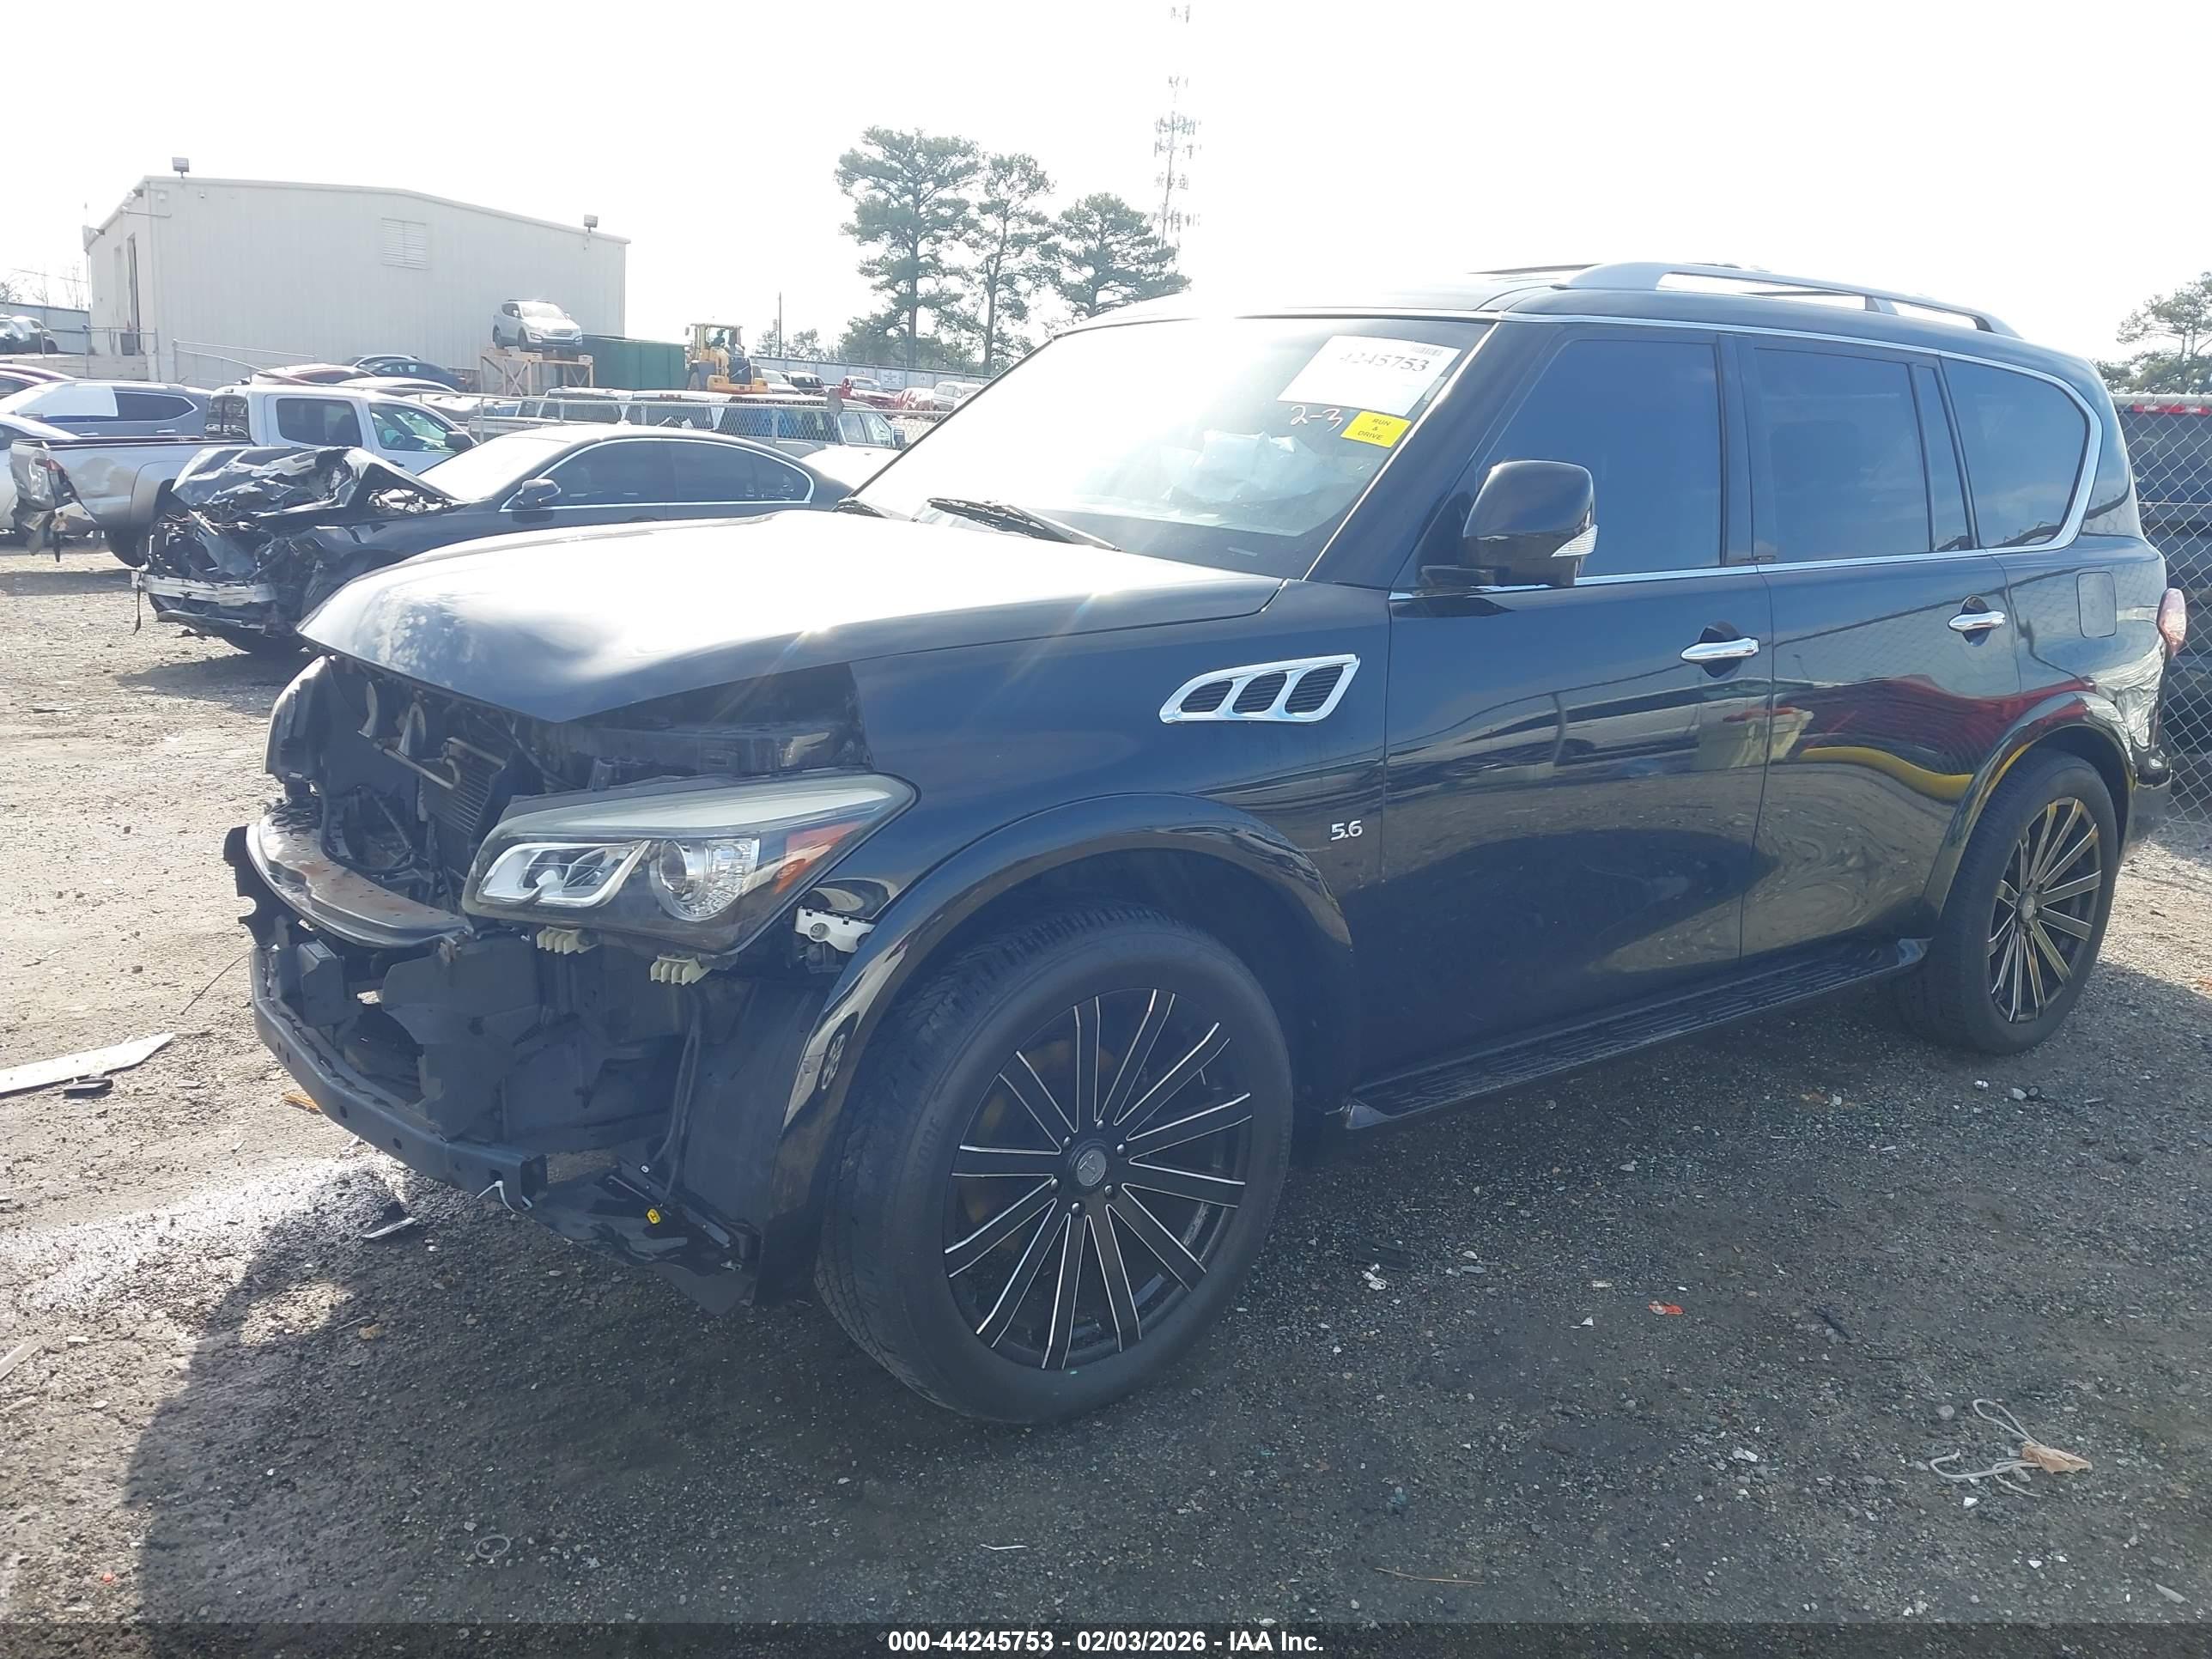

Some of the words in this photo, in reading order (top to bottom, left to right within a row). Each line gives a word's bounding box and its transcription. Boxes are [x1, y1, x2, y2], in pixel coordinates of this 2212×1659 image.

[1371, 417, 1391, 427] RUN
[1357, 430, 1385, 441] DRIVE
[1330, 819, 1364, 842] 5.6
